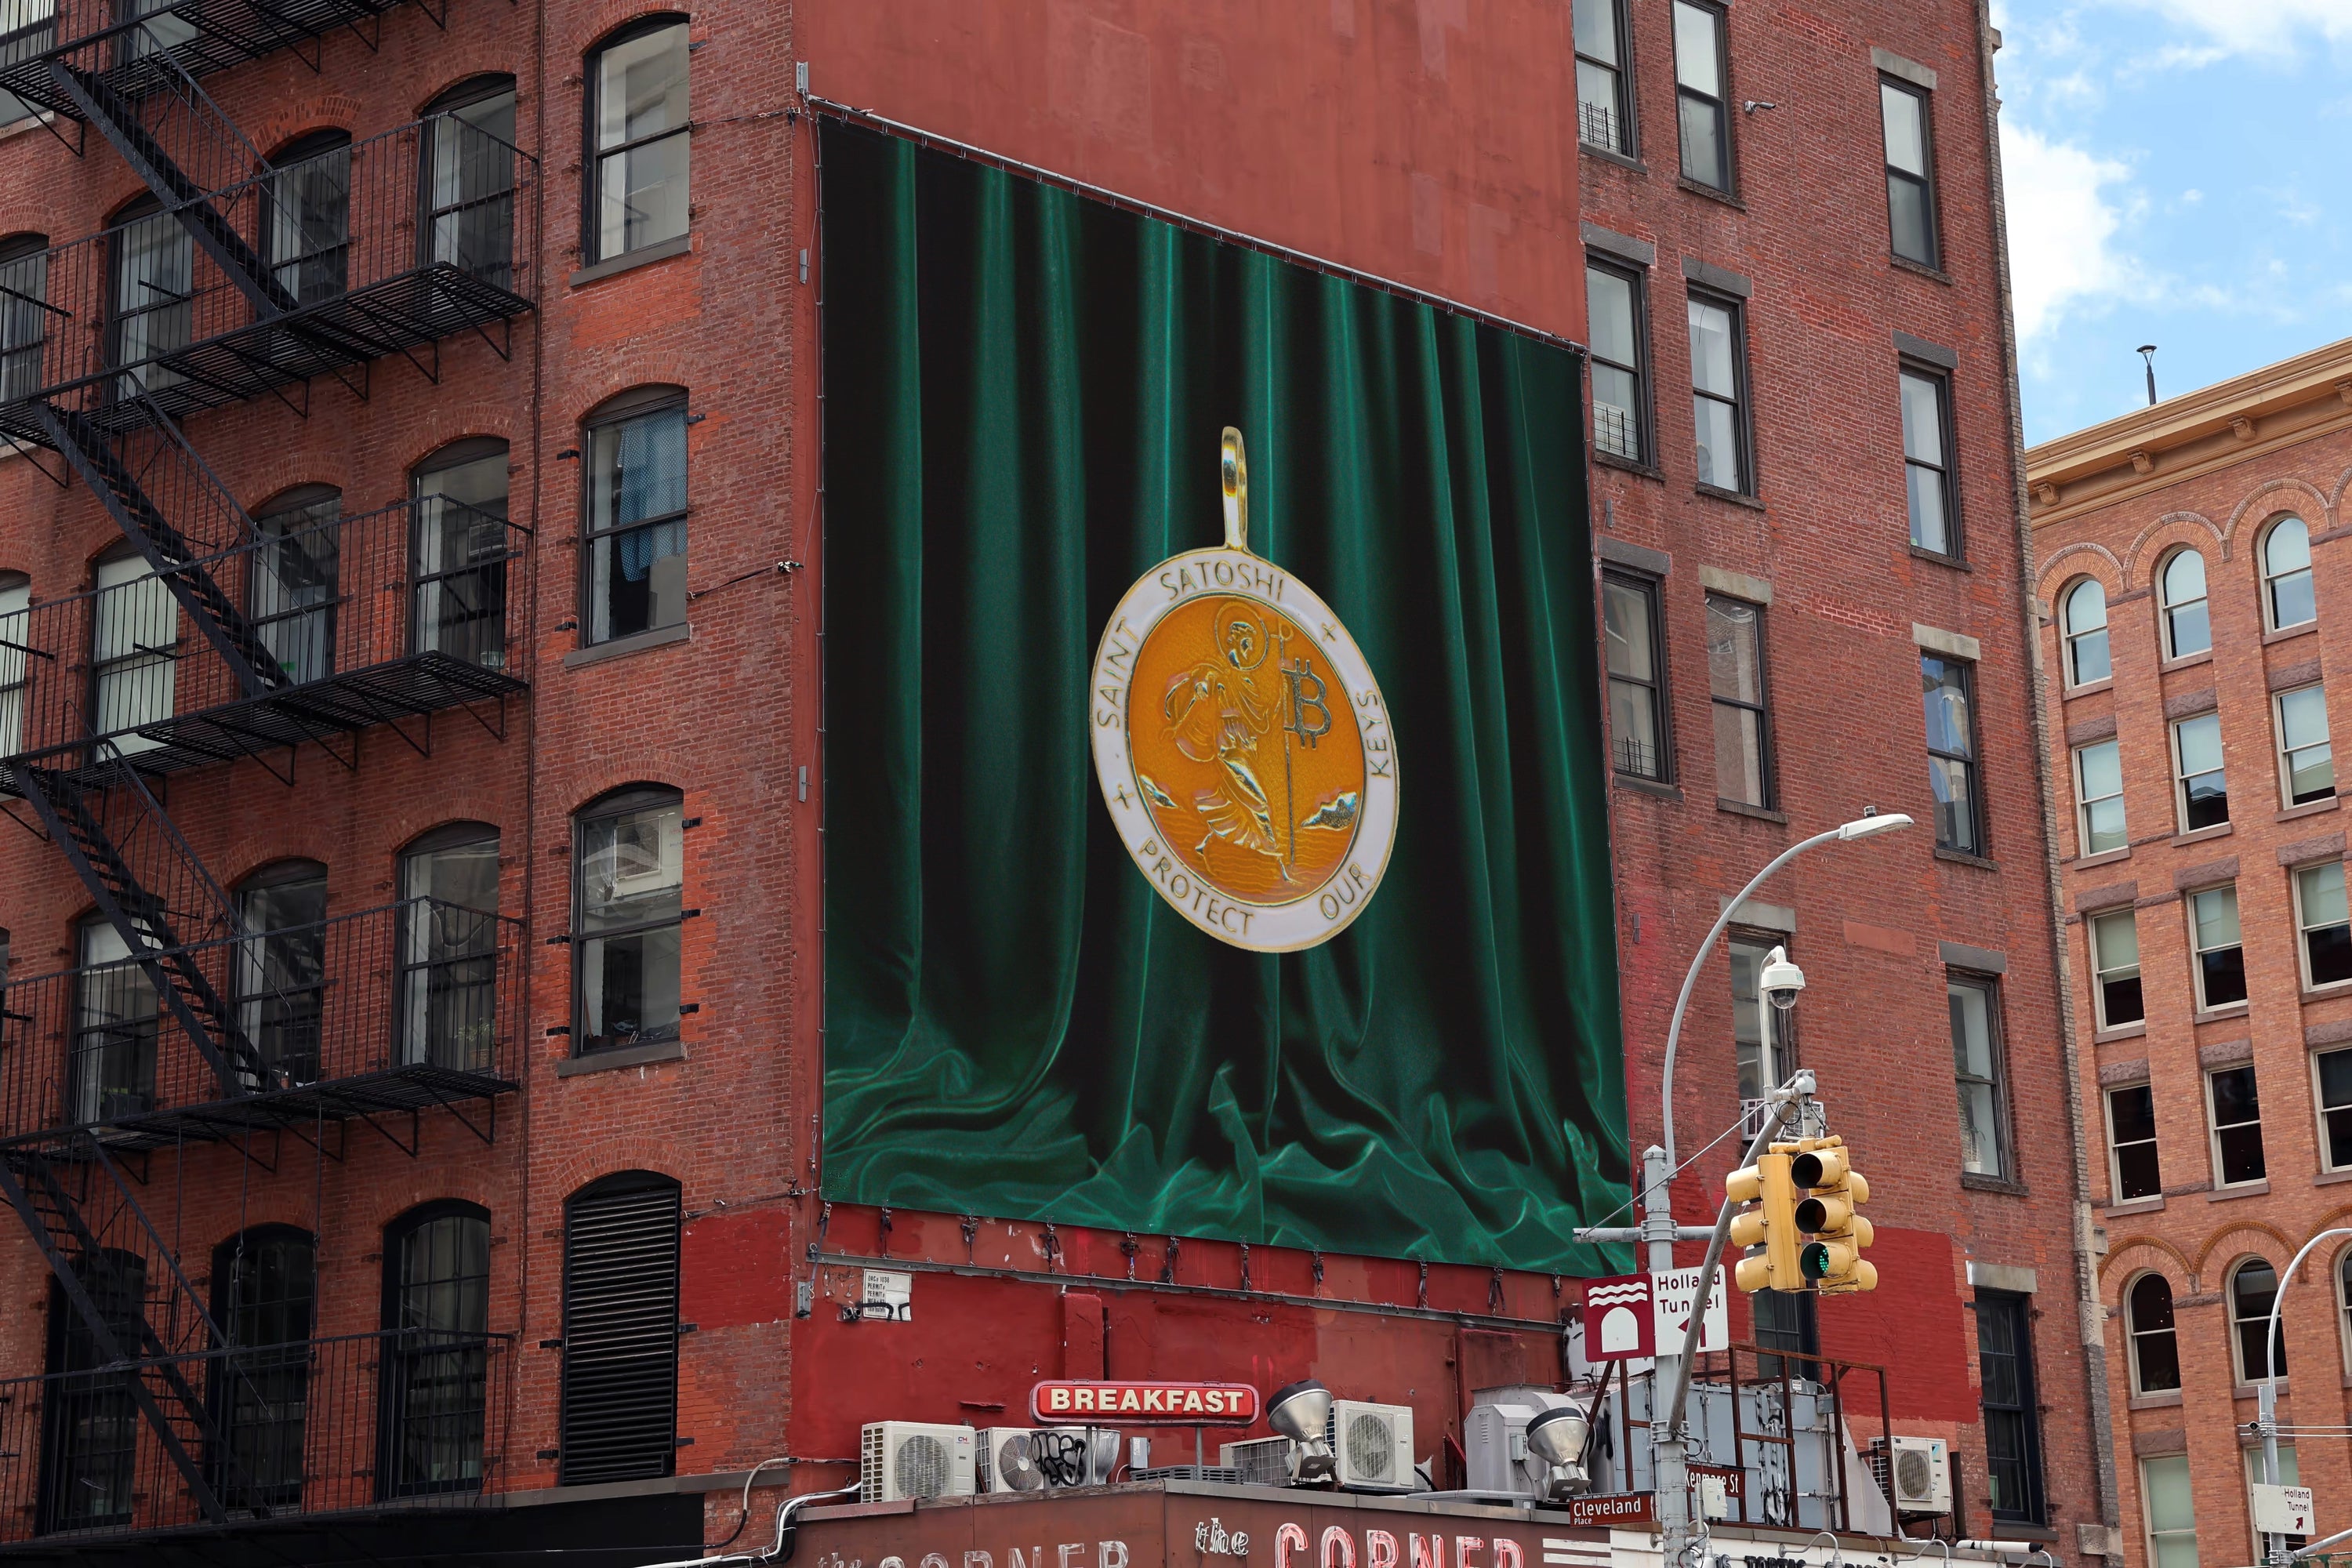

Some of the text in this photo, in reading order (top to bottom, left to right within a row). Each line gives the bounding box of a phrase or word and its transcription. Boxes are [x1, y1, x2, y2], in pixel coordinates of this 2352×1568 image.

[1097, 559, 1283, 728] SAINT SATOSHI
[1138, 689, 1392, 935] PROTECT OUR KEYS
[1657, 1270, 1721, 1291] Hollad
[1659, 1294, 1719, 1314] Tunel
[1051, 1388, 1243, 1413] BREAKFAST
[1730, 1474, 1739, 1494] St
[2285, 1488, 2310, 1499] Holland
[1573, 1497, 1641, 1517] Cleveland
[2288, 1501, 2310, 1512] Tunnel
[1195, 1517, 1250, 1555] the
